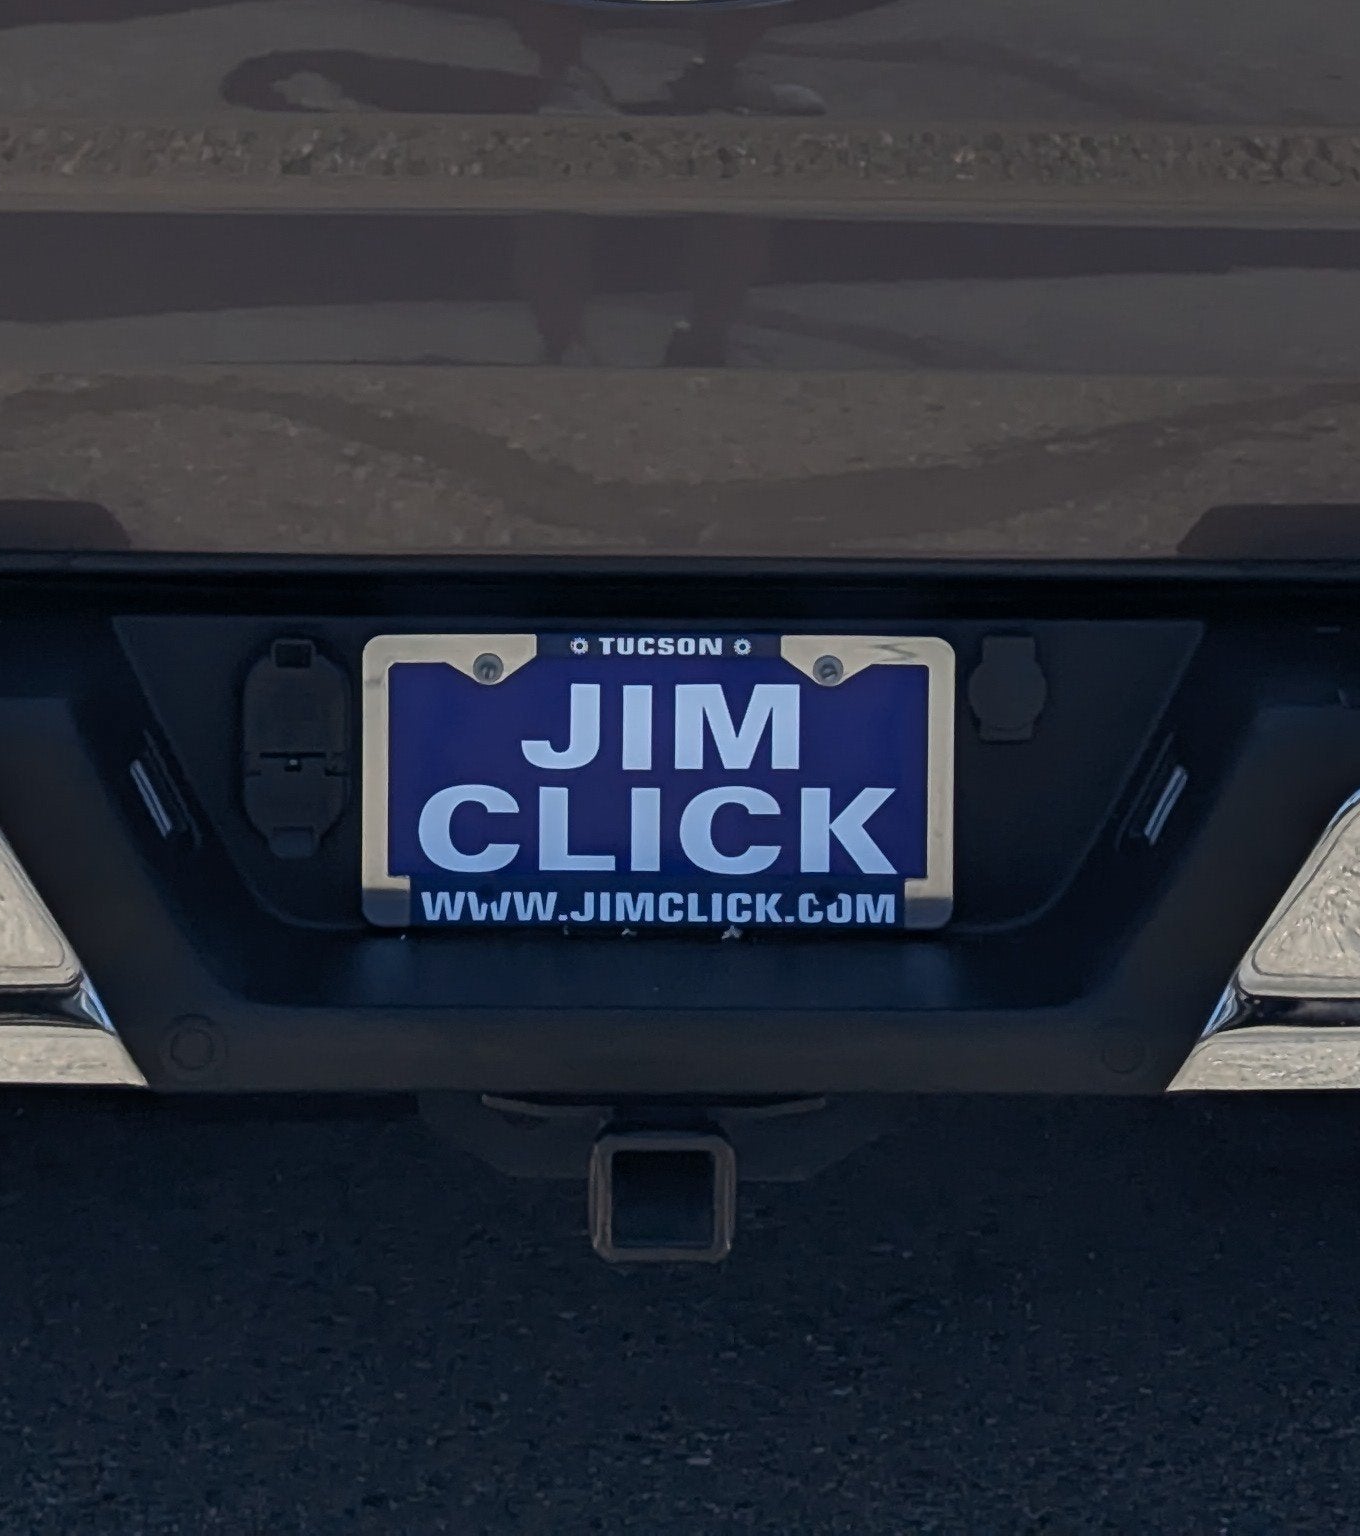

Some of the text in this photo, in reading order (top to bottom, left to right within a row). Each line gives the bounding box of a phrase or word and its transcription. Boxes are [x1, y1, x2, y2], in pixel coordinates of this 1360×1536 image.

[599, 636, 723, 657] TUCSON
[520, 683, 801, 771] JIM
[417, 784, 898, 875] CLICK
[420, 891, 897, 924] WWW.JIMCLICK.COM
